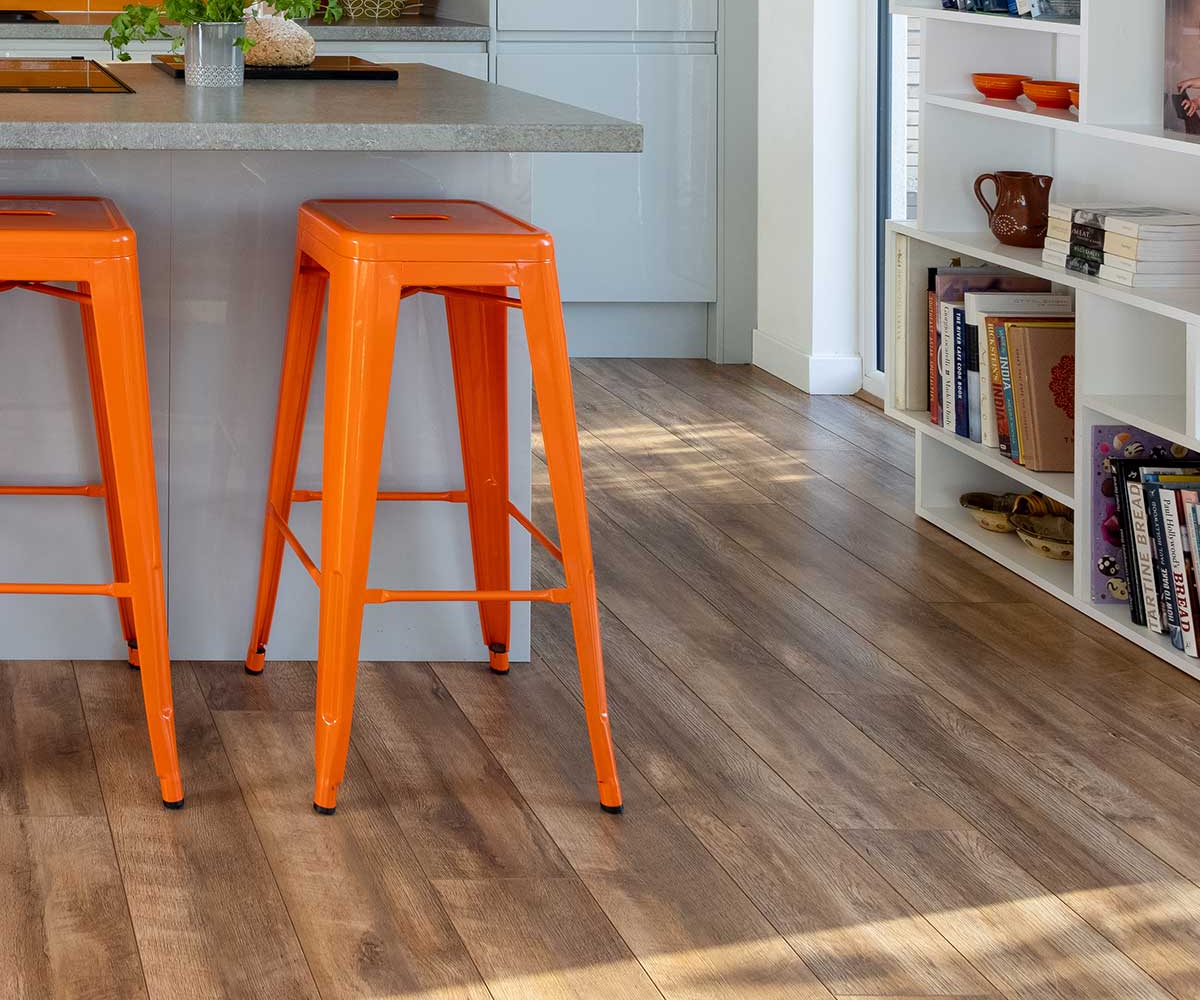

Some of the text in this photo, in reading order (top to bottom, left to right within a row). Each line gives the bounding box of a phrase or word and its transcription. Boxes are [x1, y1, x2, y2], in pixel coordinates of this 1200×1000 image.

[986, 322, 1006, 421] RICK STEIN'S INDIA
[999, 356, 1011, 390] INDIA
[1151, 501, 1163, 545] HOLLYWOOD
[1130, 484, 1158, 629] TARTINE BREAD
[1161, 567, 1170, 590] BAKE
[1164, 499, 1190, 632] Paul Hollywood's BREAD
[1164, 590, 1171, 600] TO
